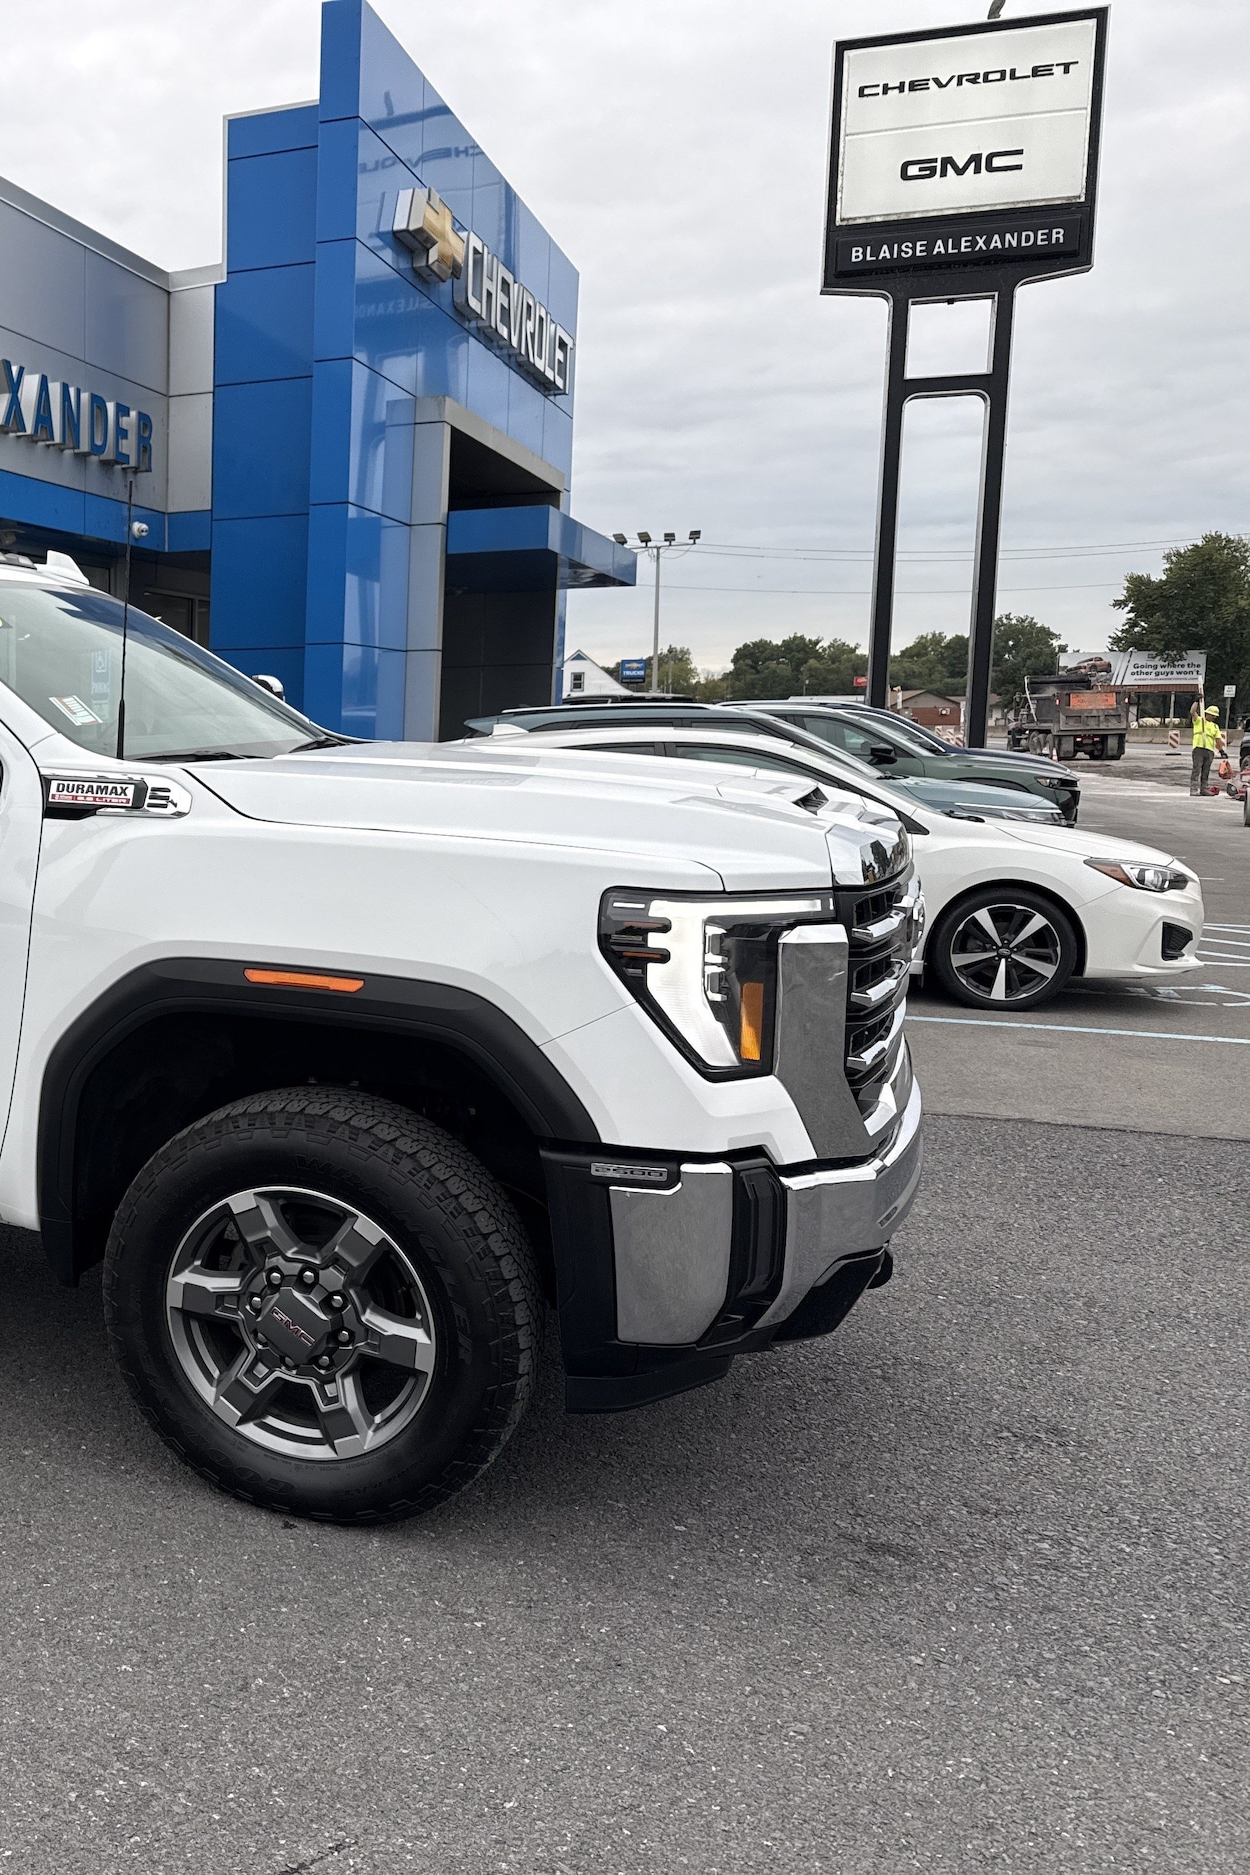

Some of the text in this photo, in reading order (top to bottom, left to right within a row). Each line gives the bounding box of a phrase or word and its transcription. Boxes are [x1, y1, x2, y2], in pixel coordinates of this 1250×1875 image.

[858, 61, 1079, 98] CHEVROLET
[900, 148, 1024, 181] GMC
[851, 228, 1065, 262] BLAISE ALEXANDER
[454, 231, 574, 395] CHEVROLET
[1133, 663, 1158, 671] Going
[1160, 662, 1186, 670] where
[55, 782, 129, 797] DURAMAX
[270, 1306, 316, 1347] GMC
